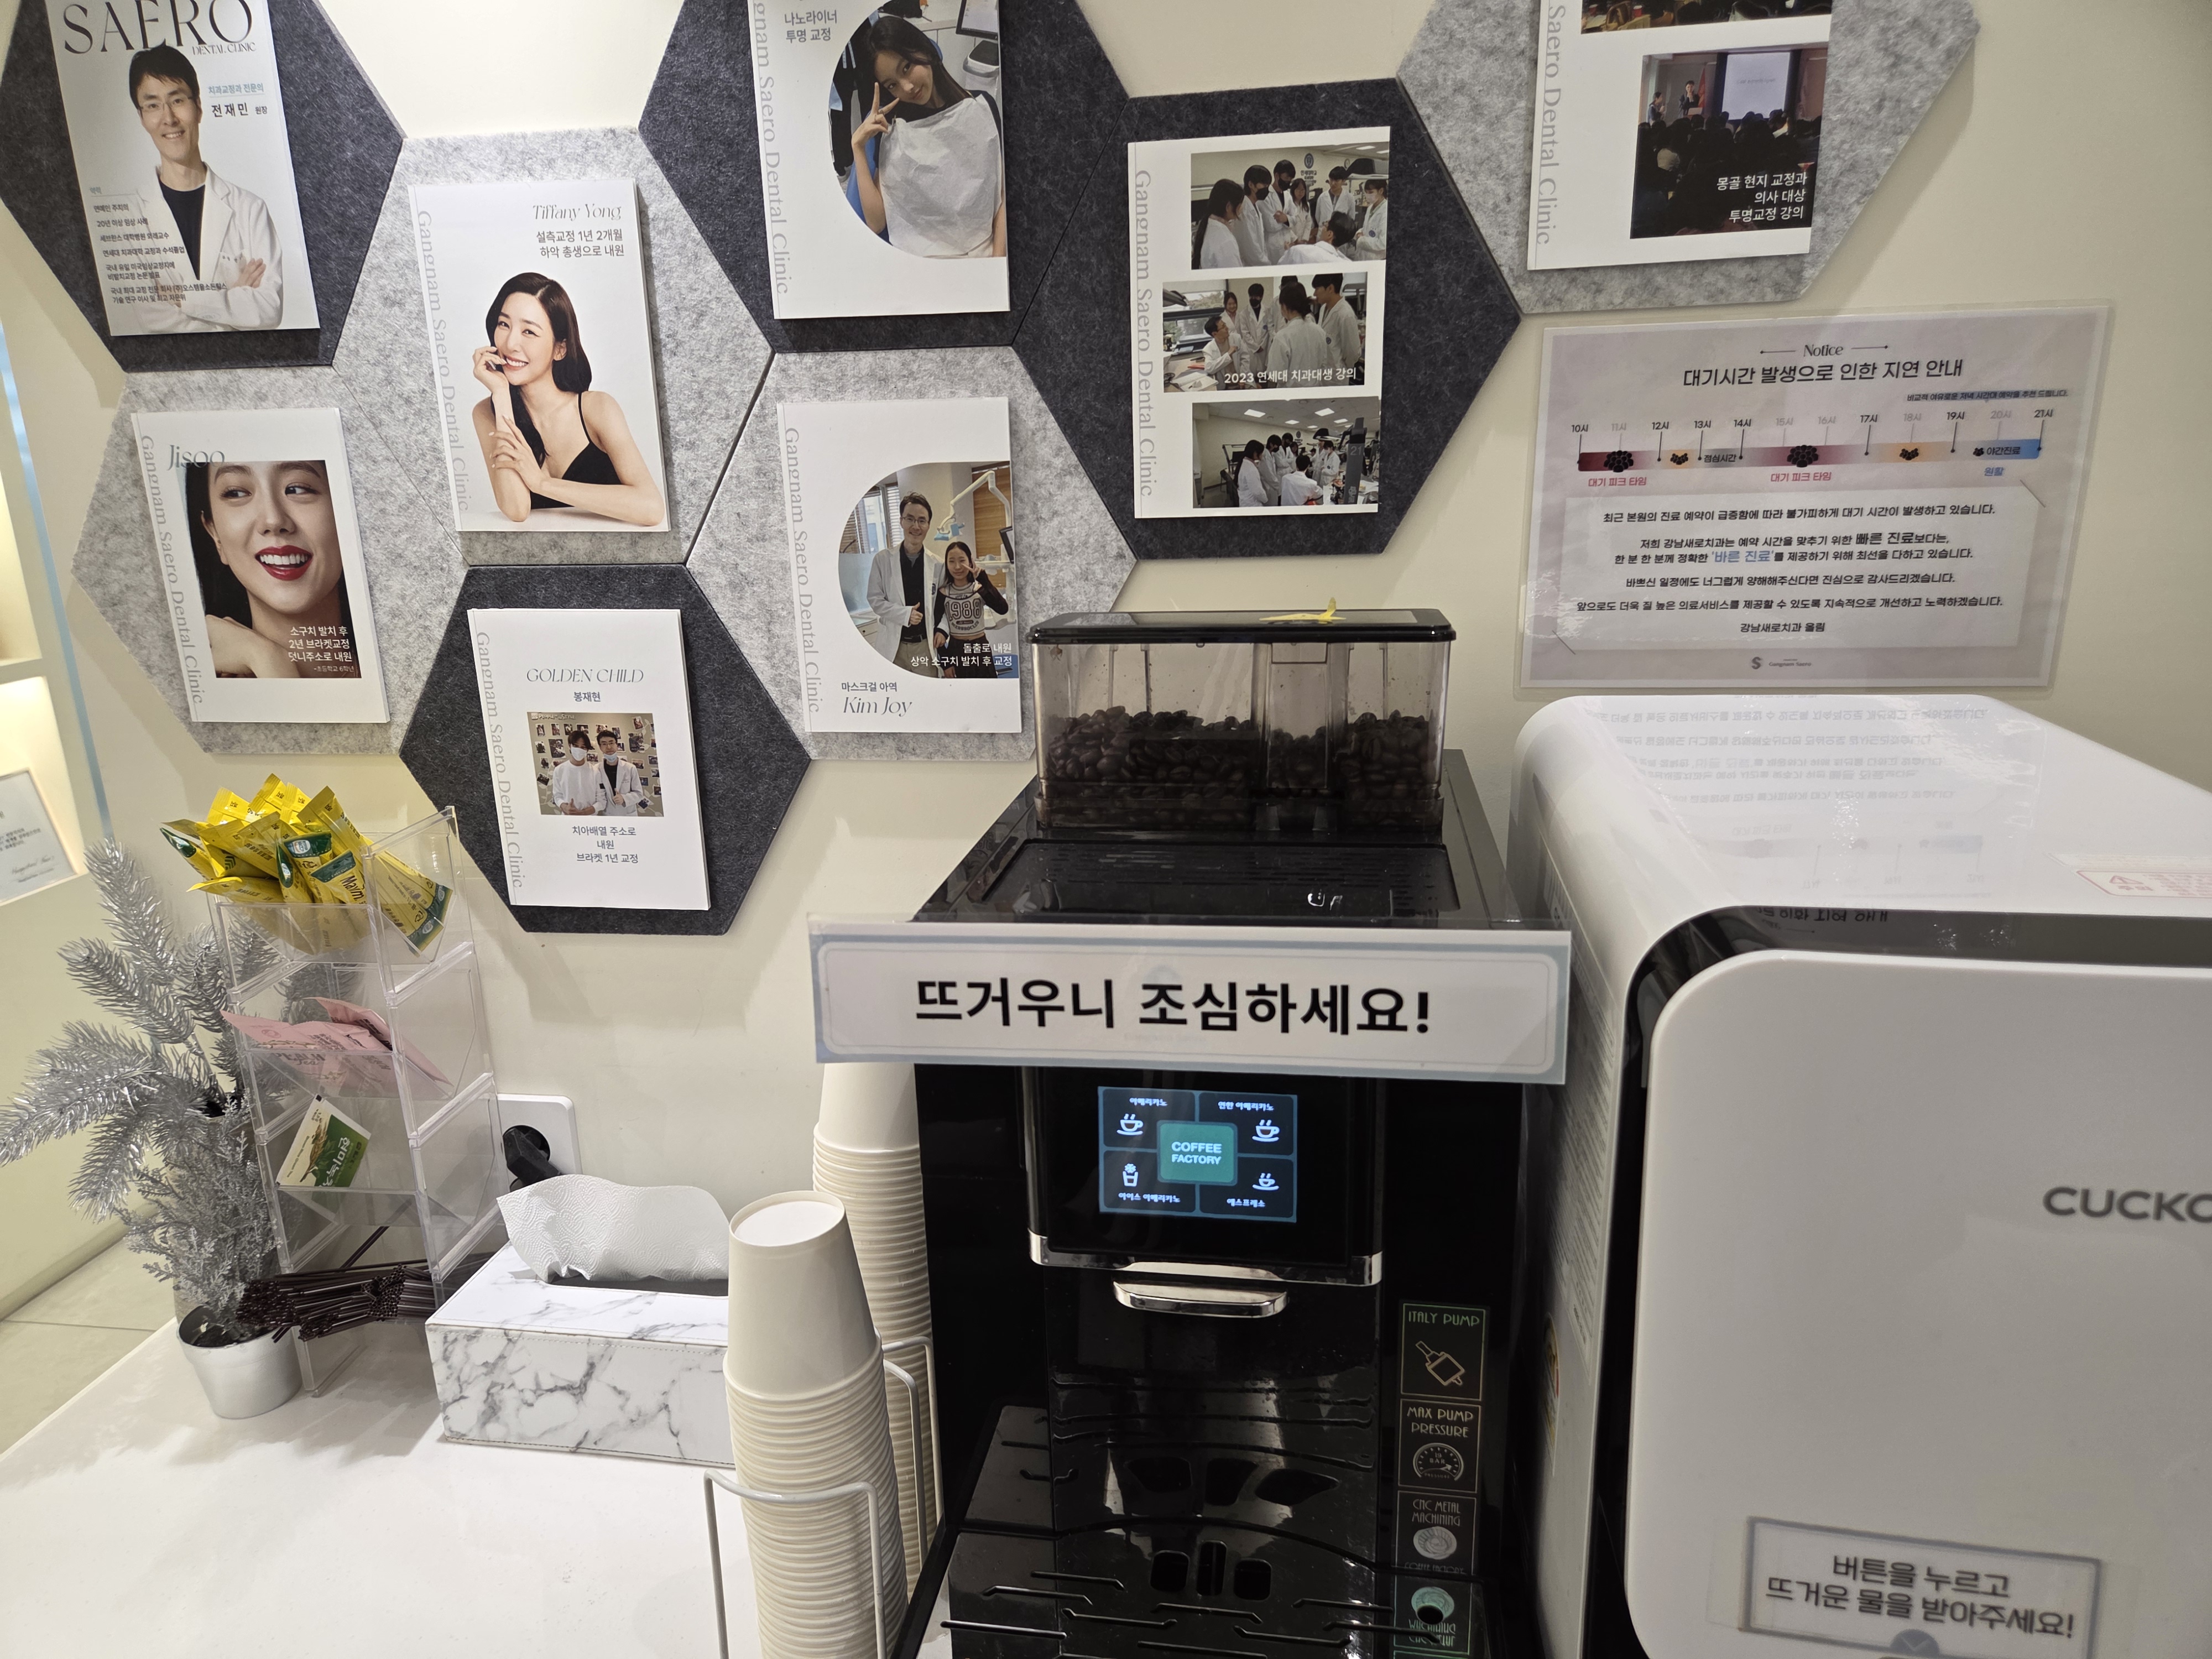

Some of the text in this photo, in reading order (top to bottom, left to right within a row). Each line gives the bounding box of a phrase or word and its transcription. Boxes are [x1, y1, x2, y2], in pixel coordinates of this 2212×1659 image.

[784, 9, 837, 26] 나노라이너
[786, 27, 831, 44] 투명 교정
[227, 42, 257, 53] CLINIC
[255, 106, 268, 114] 원장
[1717, 172, 1807, 191] 몽골 현지 교정과
[1754, 189, 1806, 205] 의사 대상
[533, 203, 622, 221] Tiffany Yong
[1729, 205, 1804, 223] 투명교정 강의
[112, 219, 123, 227] 이상
[536, 228, 623, 243] 설측교정 1년 2개월
[540, 244, 624, 259] 하악 총생으로 내원
[1135, 170, 1158, 498] Gangnam Saero Dental Clinic
[1803, 345, 1844, 357] Notice
[419, 210, 472, 512] Gangnam Saero Dental Clinic
[1224, 368, 1357, 383] 2023 연세대 치과대생 강의
[1683, 359, 1963, 387] 대기시간 발생으로 인한 지연 안내
[1860, 414, 1878, 423] 17시
[1947, 411, 1965, 421] 19시
[1571, 424, 1589, 432] 10시
[1652, 421, 1669, 430] 12시
[1694, 420, 1712, 429] 13시
[1734, 419, 1752, 427] 14시
[1986, 446, 2021, 456] 야간진료
[167, 444, 225, 472] Jisoo
[1703, 453, 1737, 463] 점심시간
[1588, 477, 1647, 488] 대기 피크 타임
[1770, 472, 1832, 482] 대기 피크 타임
[1603, 504, 1996, 523] 최근 본원의 진료 예약이 급증함에 따라 불가피하게 대기 시간이 발생하고 있습니다.
[1640, 533, 1882, 549] 저희 강남새로치과는 예약 시간을 맞추기 위한 빠른
[1654, 549, 1973, 564] 분께 정확한 제공하기 위해 최선을 다하고 있습니다.
[785, 427, 822, 713] Gangnam Saero Dental Clinic
[1626, 573, 1955, 588] 바쁘신 일정에도 너그럽게 진심으로 감사드리겠습니다.
[945, 598, 981, 622] 1988
[1577, 596, 2003, 612] 앞으로도 더욱 수 있도록 지속적으로 개선하고 노력하겠습니다.
[290, 625, 348, 637] 소구치 발치 후
[1740, 622, 1825, 633] 강남새로치과 올림
[289, 639, 349, 649] 2년 브라켓교정
[963, 643, 1012, 654] 돌출로 내원
[288, 651, 352, 662] 덧니주소로 내원
[911, 656, 1013, 667] 상악 소구치 발치 후 교정
[526, 669, 644, 683] GOLDEN CHILD
[841, 682, 897, 692] 마스크걸 아역
[573, 691, 601, 702] 봉재현
[843, 697, 912, 717] Kim Joy
[572, 826, 637, 836] 치아배열 주소로
[597, 839, 614, 849] 내원
[577, 853, 638, 864] 브라켓 1년 교정
[915, 979, 1428, 1035] 뜨거우니 조심하세요!
[1129, 1098, 1168, 1107] 아메리카노
[1171, 1141, 1222, 1154] COFFEE
[1171, 1154, 1222, 1165] FACTORY
[1118, 1193, 1181, 1203] 아이스 아메리카노
[1227, 1198, 1266, 1208] 에스프레소
[1408, 1311, 1480, 1327] ITALY PUMP
[1407, 1406, 1473, 1422] MAX PUMP
[1411, 1422, 1469, 1438] PRESSURE
[1412, 1499, 1461, 1514] CNC METAL
[1412, 1512, 1460, 1527] MACHINING
[1832, 1555, 2010, 1598] 버튼을 누르고
[1765, 1576, 2074, 1639] 뜨거운 물을 받아주세요!
